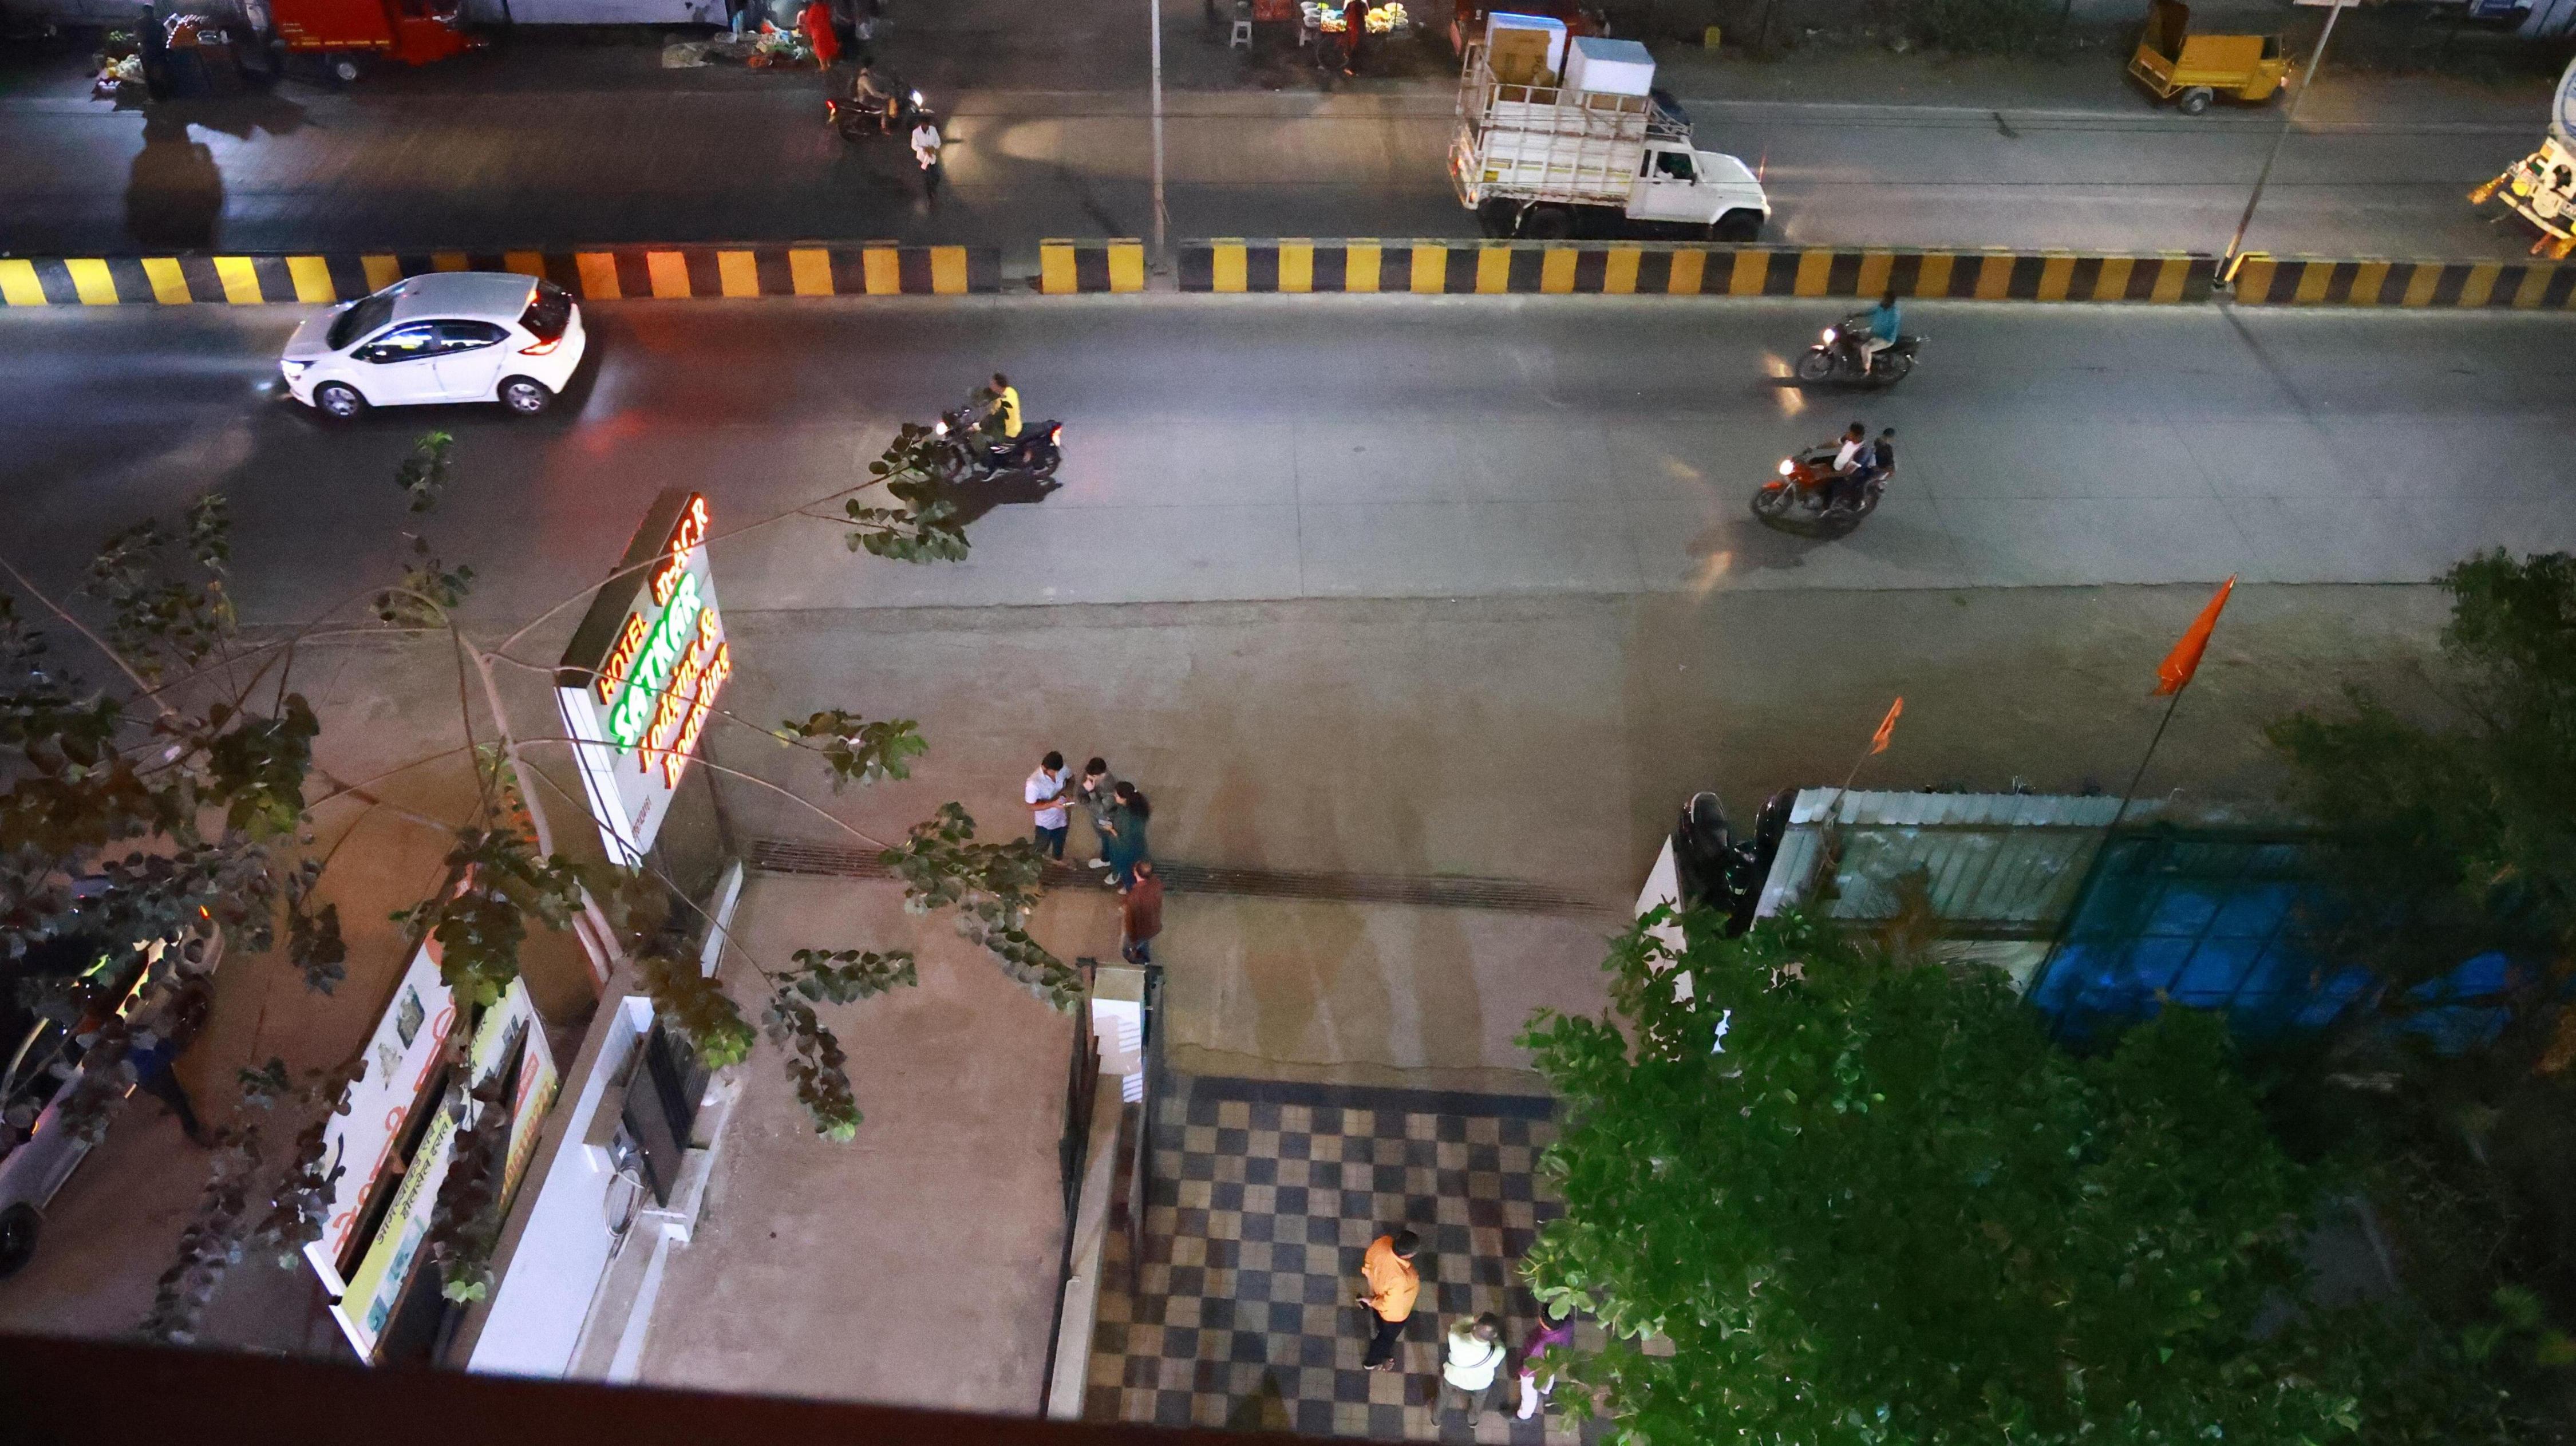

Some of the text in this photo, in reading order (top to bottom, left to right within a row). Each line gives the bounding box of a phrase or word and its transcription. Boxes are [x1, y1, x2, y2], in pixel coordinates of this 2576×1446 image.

[600, 612, 649, 705] HOTEL
[615, 572, 701, 755] SATKAR
[636, 607, 717, 773] Lodging &
[665, 642, 730, 789] Boarding
